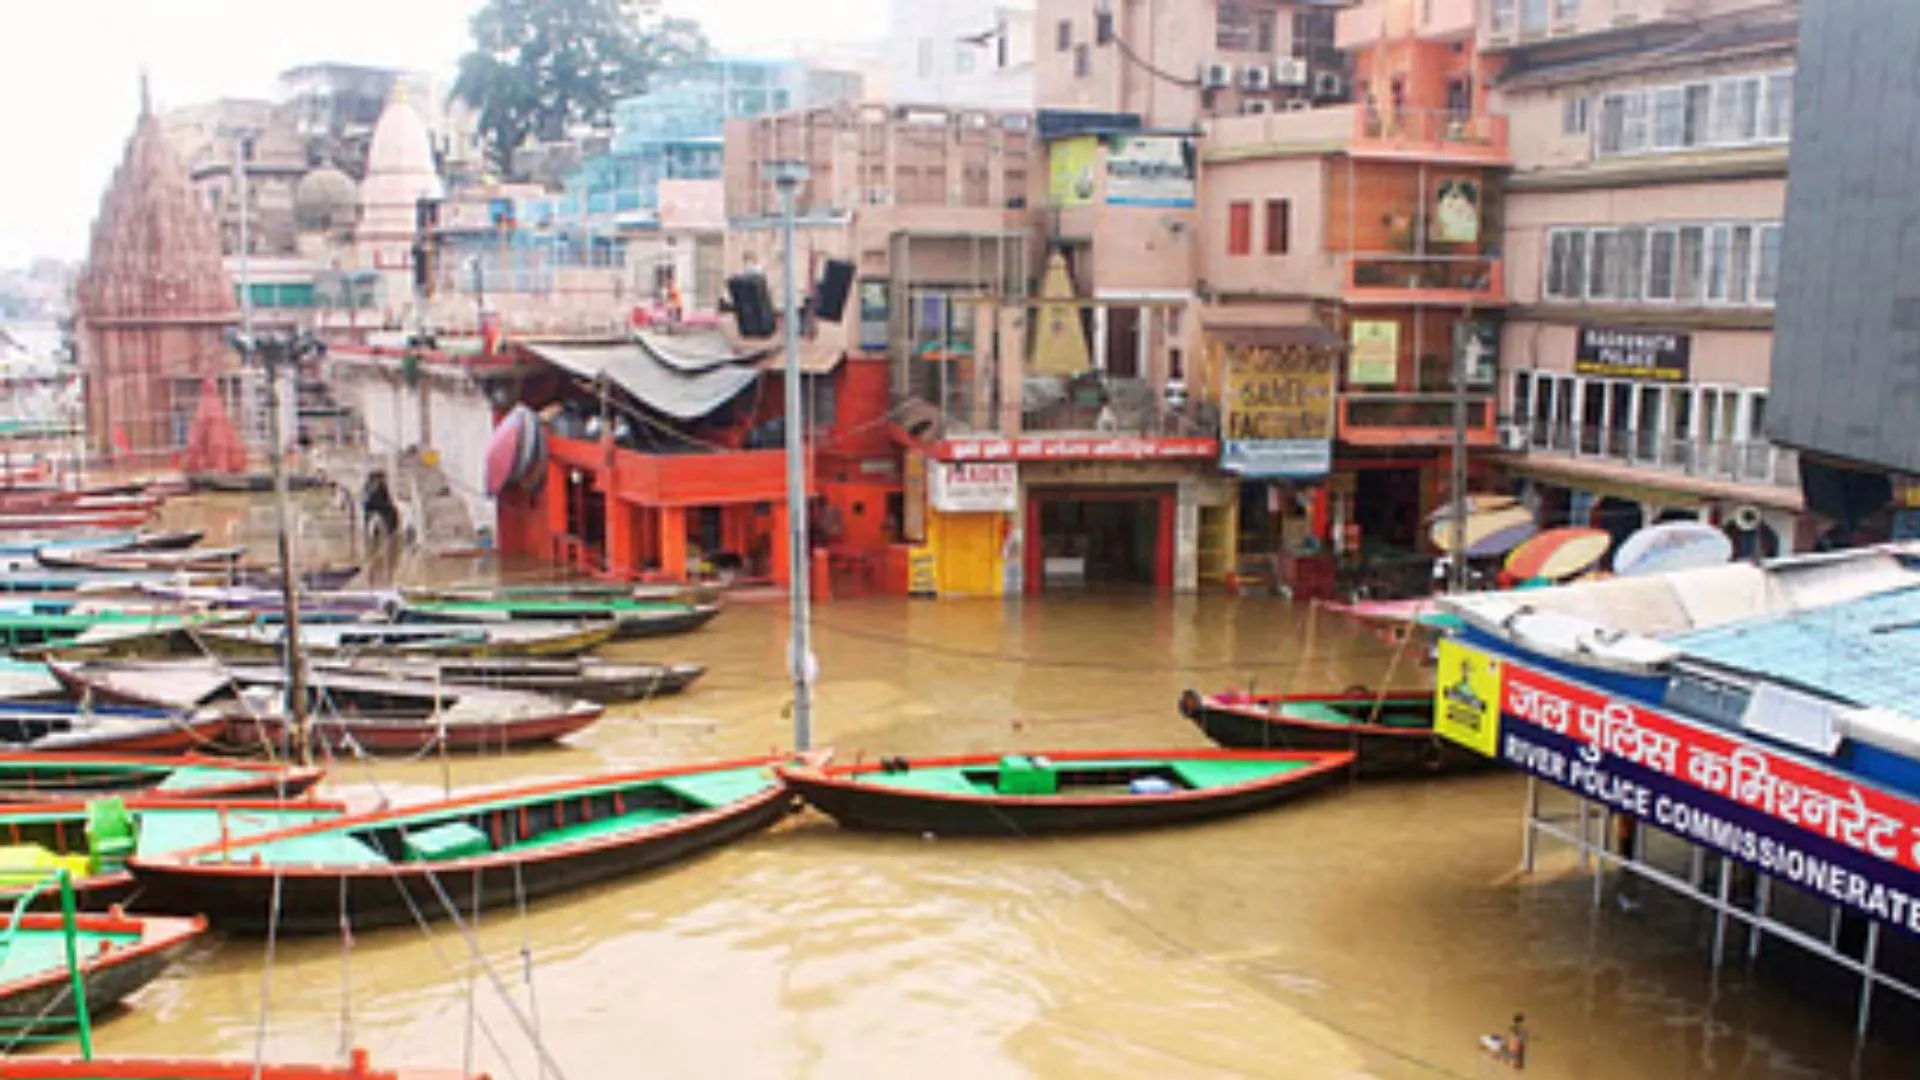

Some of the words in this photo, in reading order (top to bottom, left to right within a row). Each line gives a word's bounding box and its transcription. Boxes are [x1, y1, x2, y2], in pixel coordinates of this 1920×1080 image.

[1504, 733, 1566, 781] RIVER
[1570, 760, 1652, 815] POLICE
[1655, 796, 1920, 934] COMMISSIONERATE
[1508, 680, 1570, 734] जल
[1578, 703, 1680, 776] पुलिस
[1688, 746, 1903, 859] कमिश्नरेट
